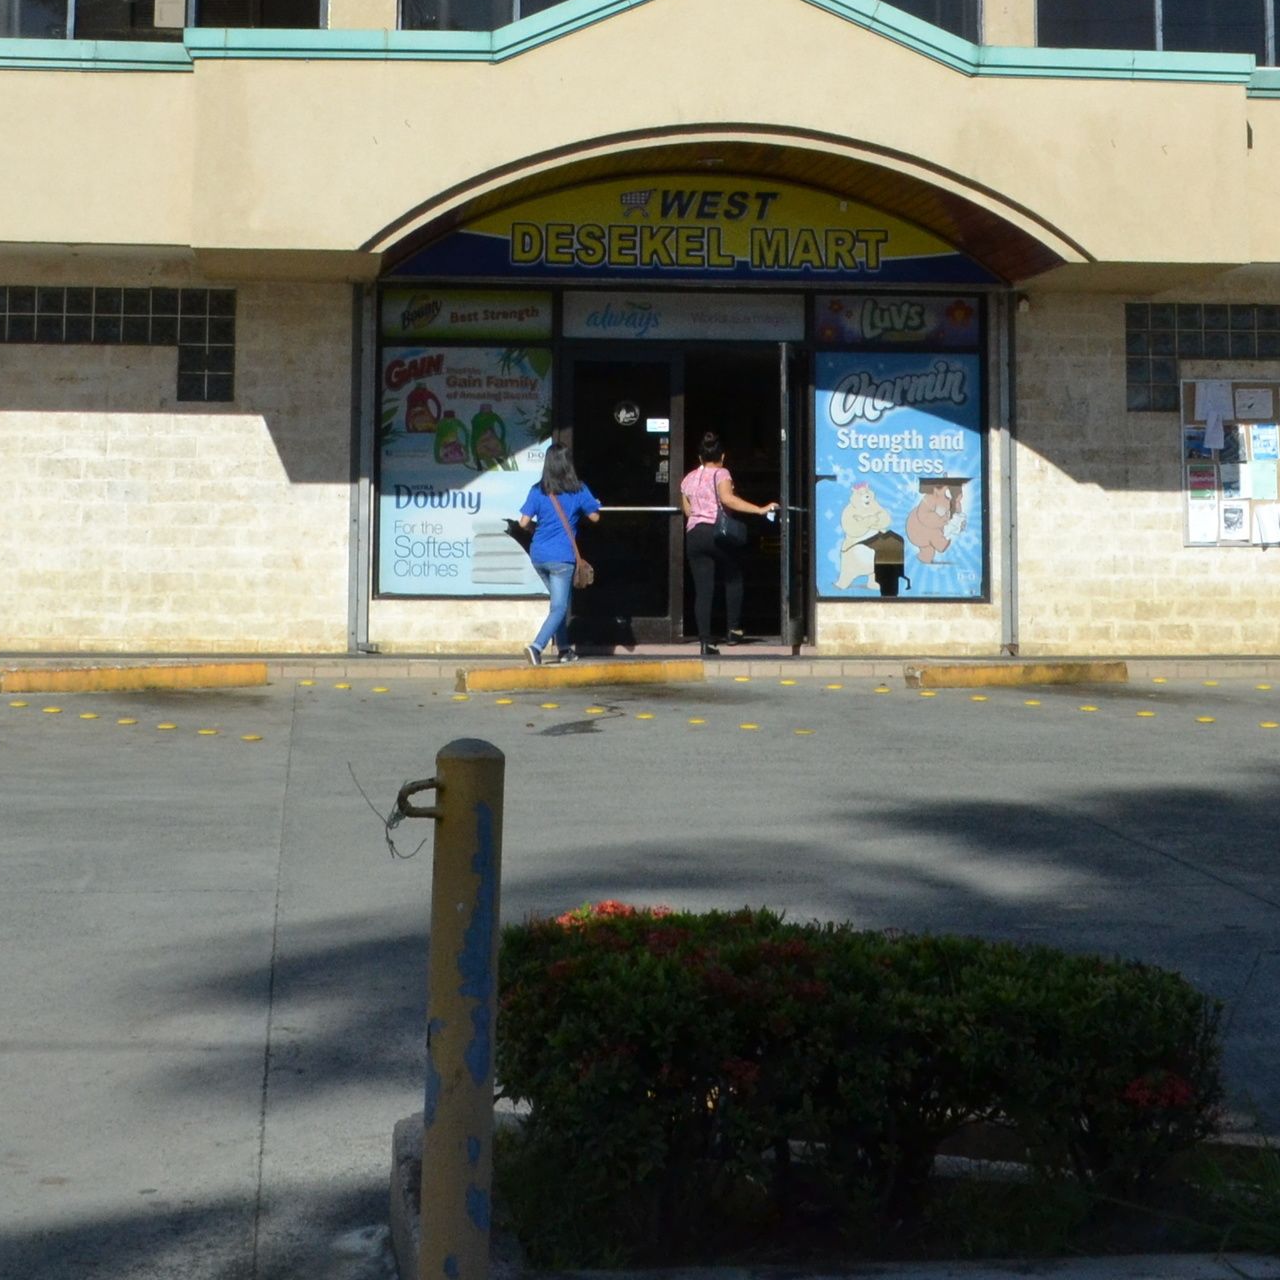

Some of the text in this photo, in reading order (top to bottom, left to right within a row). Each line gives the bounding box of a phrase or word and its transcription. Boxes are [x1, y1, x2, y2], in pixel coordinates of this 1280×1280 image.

[659, 190, 780, 219] WEST
[510, 222, 888, 271] DESEKEL MART
[401, 298, 442, 330] Bounty
[450, 305, 539, 324] Best Strength
[586, 302, 660, 336] always
[446, 375, 538, 390] Gain Family
[829, 361, 966, 427] Charmin
[837, 429, 964, 453] Strength and
[858, 452, 945, 474] Softness
[394, 484, 481, 515] Downy
[394, 520, 443, 534] For the
[394, 535, 472, 559] Softest
[393, 559, 458, 578] Clothes
